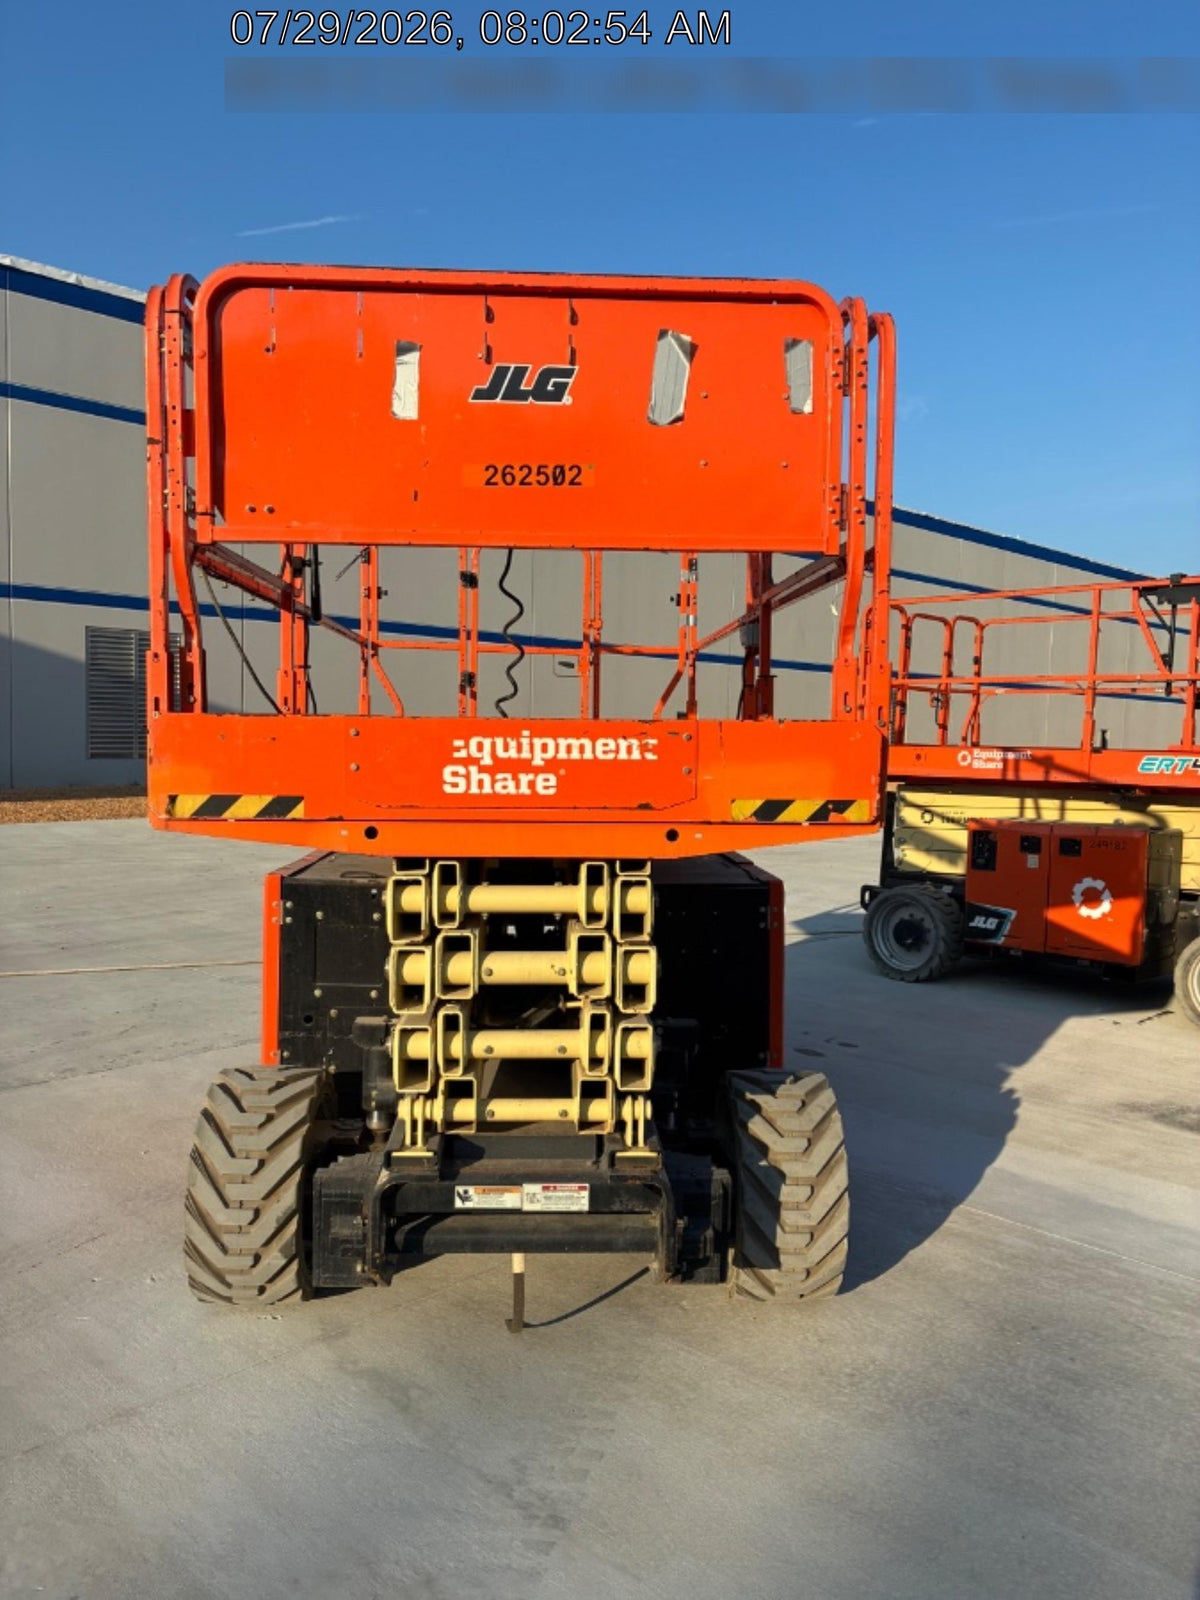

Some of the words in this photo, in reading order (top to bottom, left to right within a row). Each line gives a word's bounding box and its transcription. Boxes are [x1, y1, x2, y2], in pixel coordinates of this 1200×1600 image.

[484, 464, 582, 487] 262502
[442, 765, 557, 796] Share
[968, 915, 999, 930] JLG
